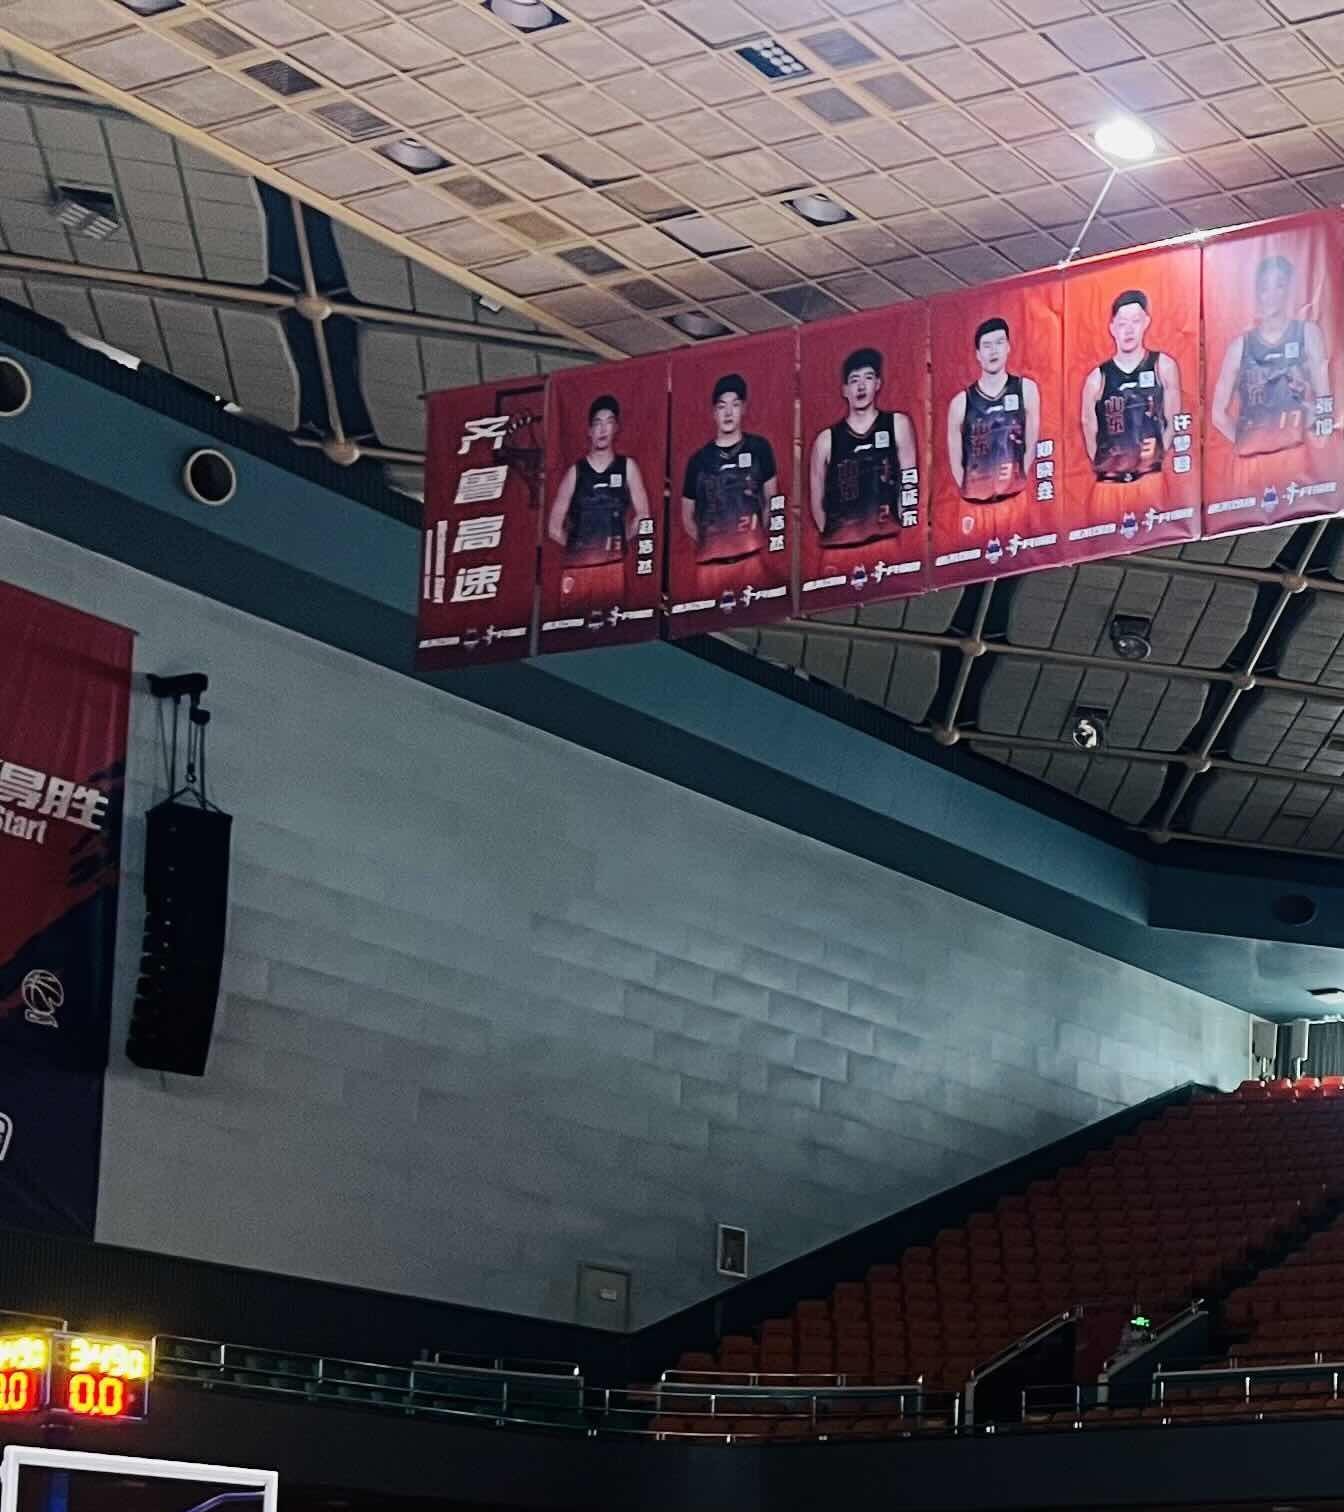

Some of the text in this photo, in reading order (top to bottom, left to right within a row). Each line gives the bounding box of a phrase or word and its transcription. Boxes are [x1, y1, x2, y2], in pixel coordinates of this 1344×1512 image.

[452, 415, 510, 603] 齐鲁高速
[0, 805, 47, 844] tart
